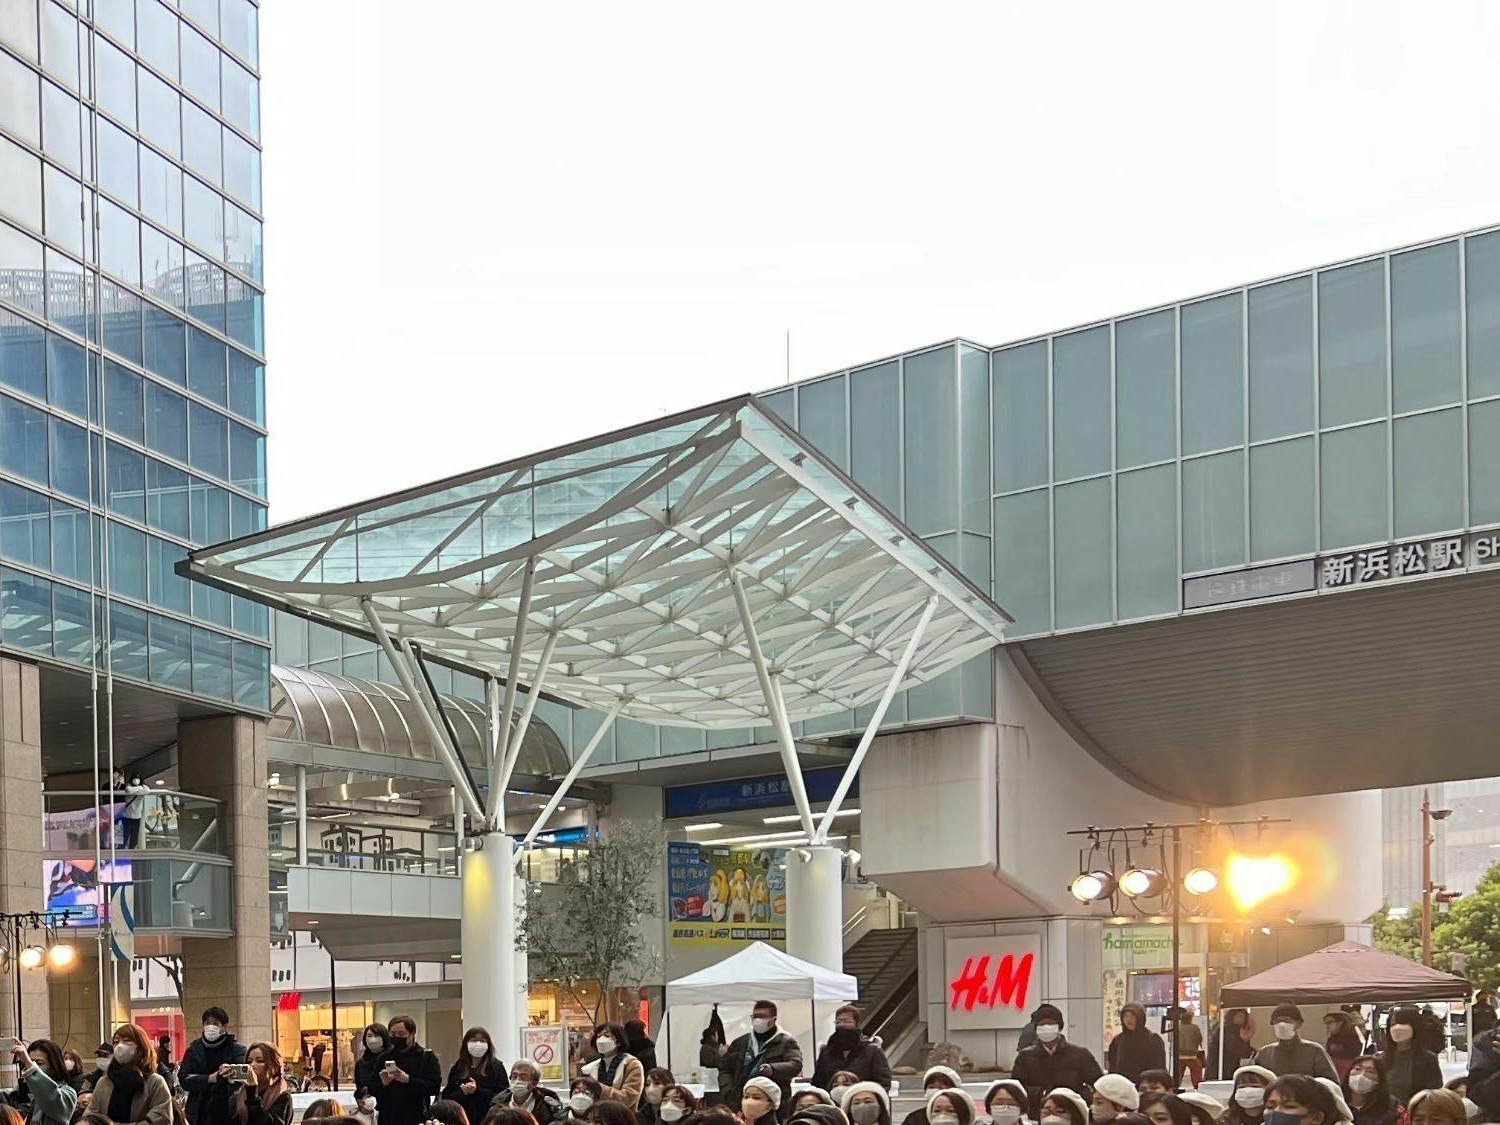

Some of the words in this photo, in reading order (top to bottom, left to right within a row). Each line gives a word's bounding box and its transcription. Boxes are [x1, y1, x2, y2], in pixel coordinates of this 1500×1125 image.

[1323, 537, 1462, 587] 新浜松駅
[950, 953, 1034, 1012] H&M
